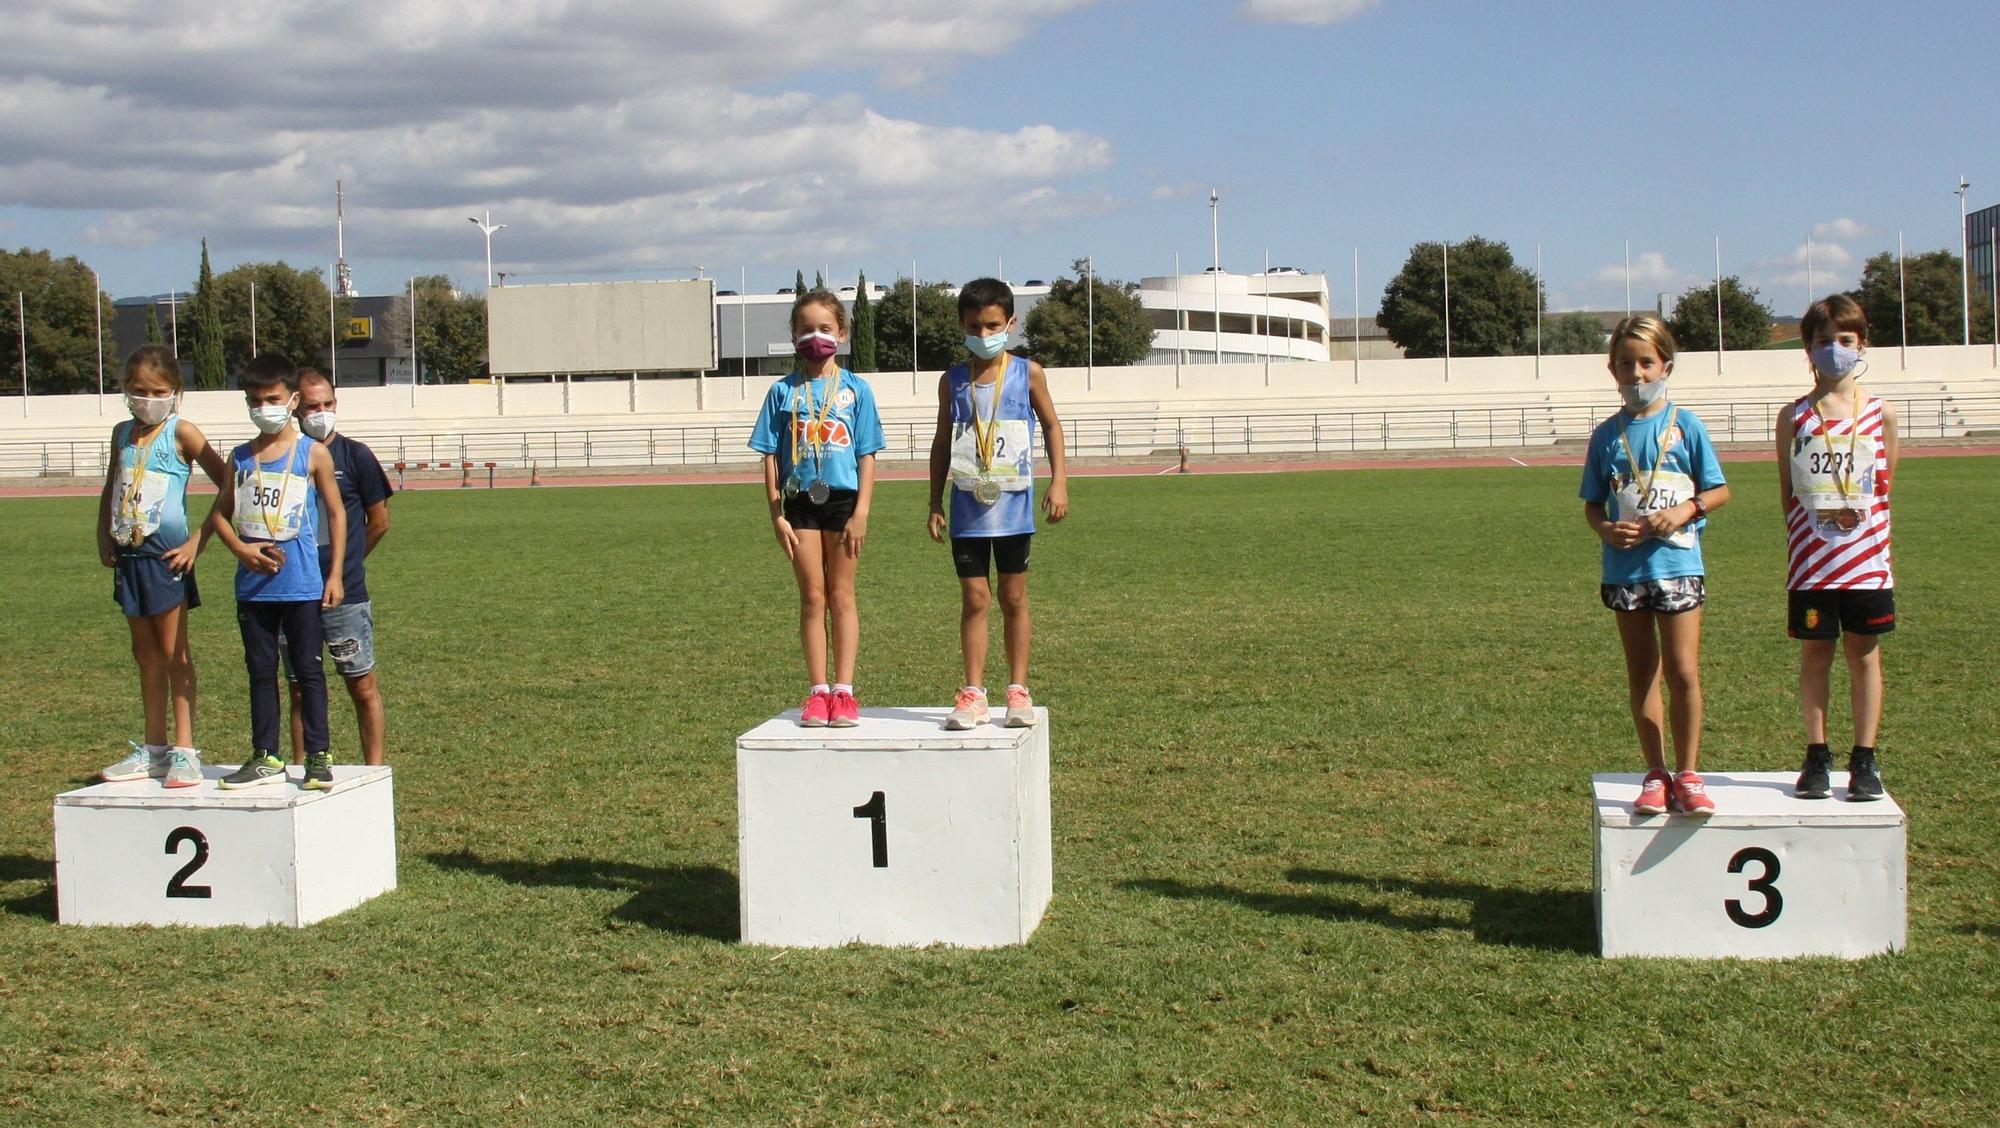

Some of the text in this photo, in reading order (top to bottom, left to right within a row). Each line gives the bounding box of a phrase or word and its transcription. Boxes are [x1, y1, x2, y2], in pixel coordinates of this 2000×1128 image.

[253, 486, 281, 508] 558
[165, 827, 211, 898] 2
[854, 792, 888, 867] 1
[1725, 847, 1783, 928] 3
